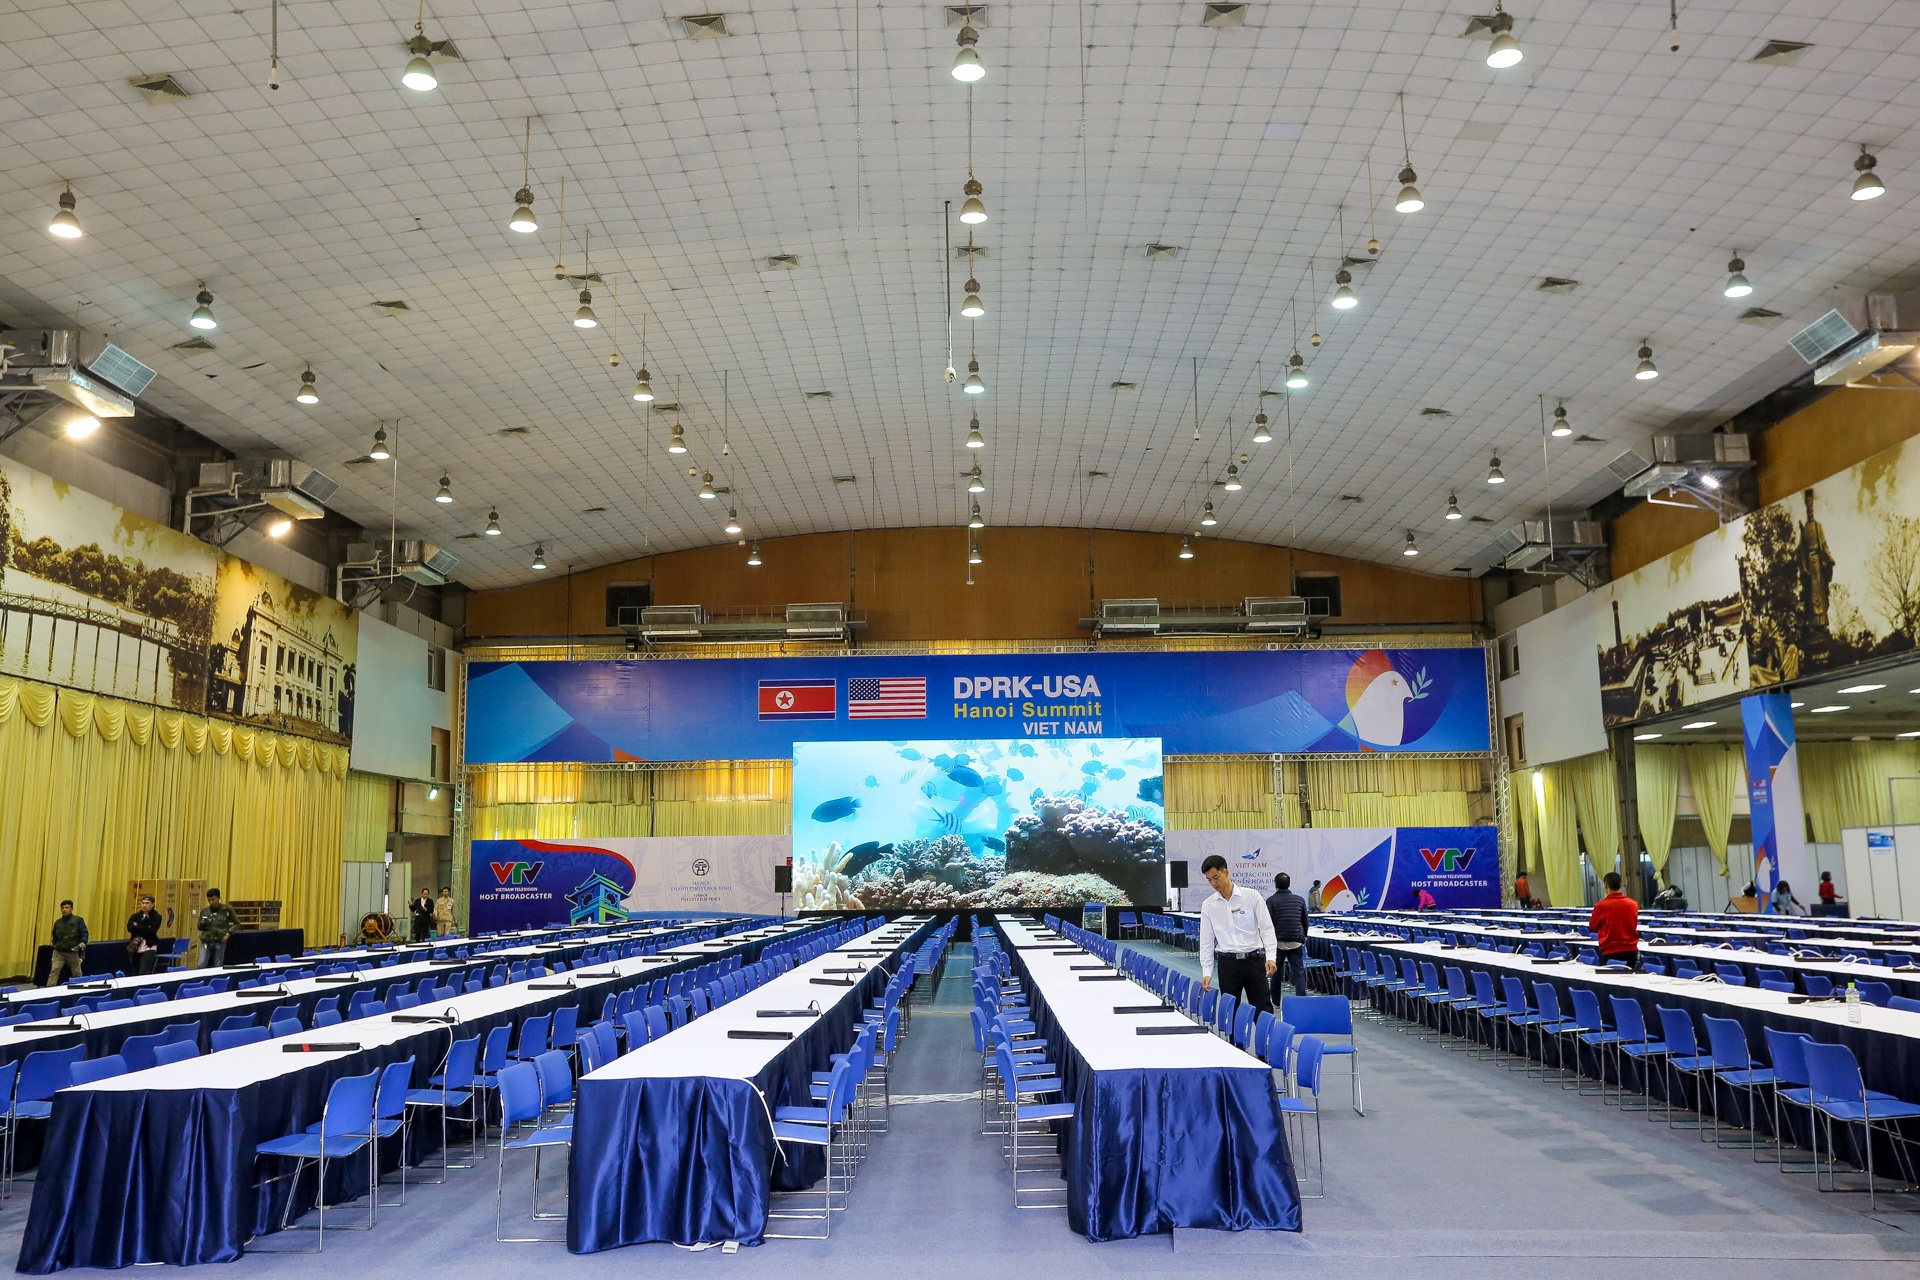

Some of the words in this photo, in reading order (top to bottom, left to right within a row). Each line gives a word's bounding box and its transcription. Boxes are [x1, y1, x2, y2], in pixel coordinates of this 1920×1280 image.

[953, 675, 1101, 699] DPRK-USA
[953, 702, 1014, 718] Hanoi
[1022, 701, 1102, 717] Summit
[1023, 721, 1060, 735] VIET
[1064, 721, 1103, 734] NAM
[1419, 848, 1476, 871] VTV
[490, 861, 544, 884] VTV
